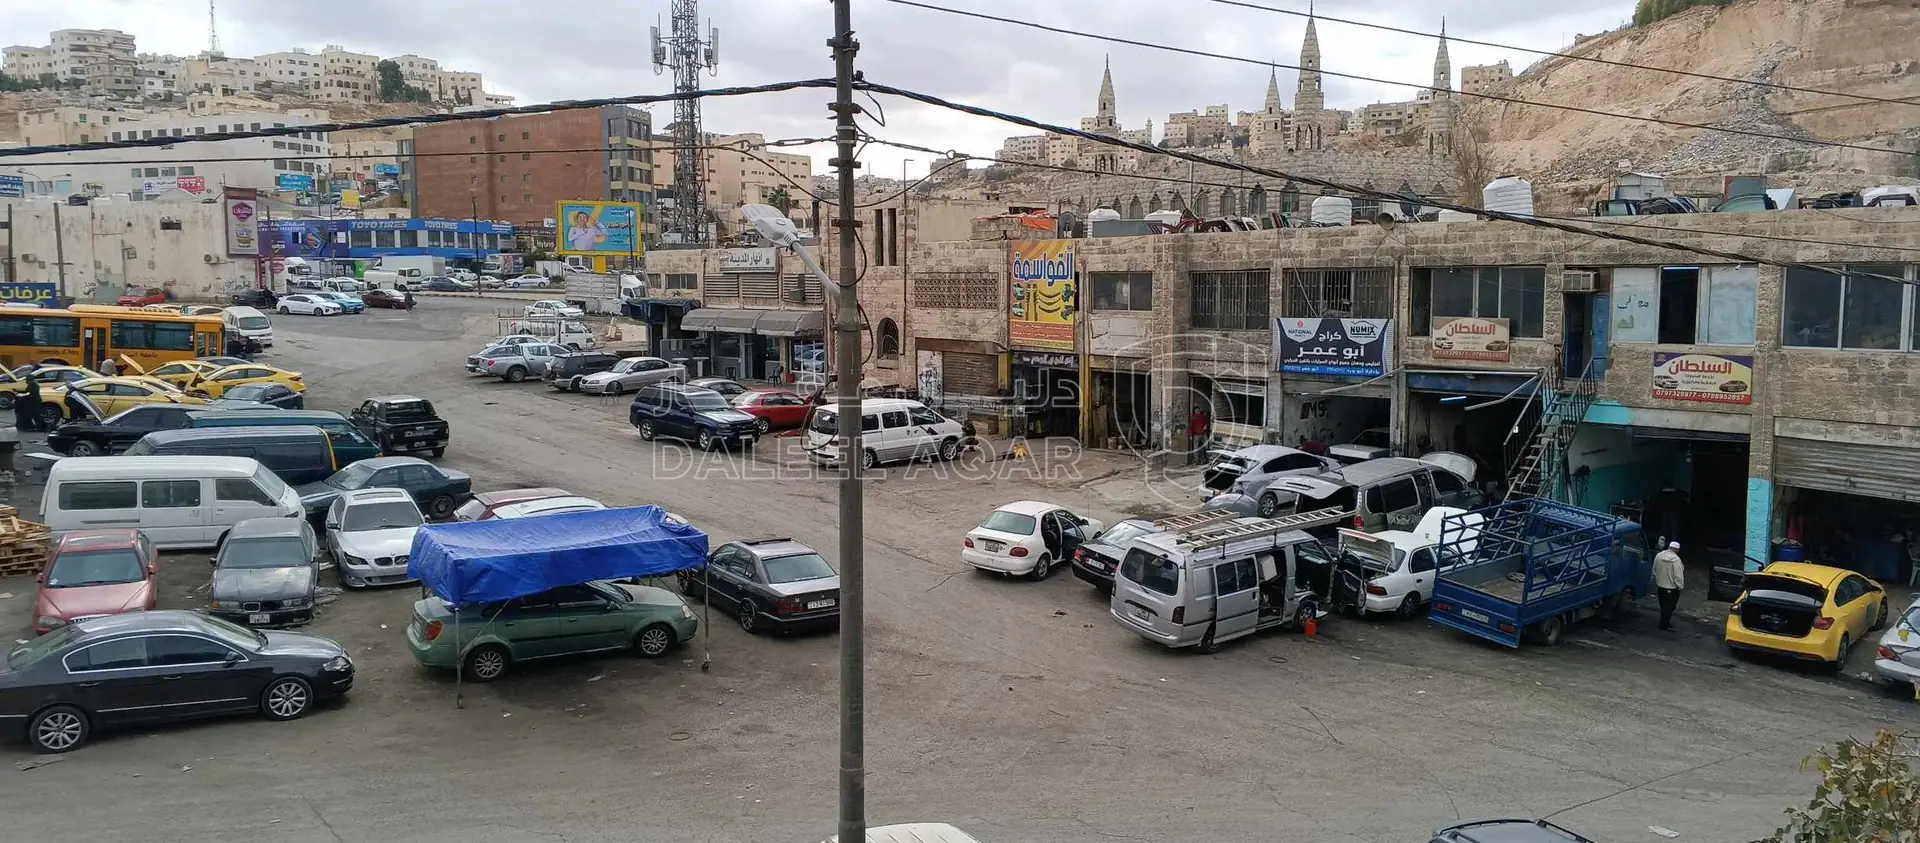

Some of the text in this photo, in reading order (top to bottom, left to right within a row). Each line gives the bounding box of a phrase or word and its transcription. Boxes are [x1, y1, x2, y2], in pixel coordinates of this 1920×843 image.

[351, 221, 407, 229] TOYO TIRES
[0, 286, 52, 301] عرفات
[1350, 326, 1376, 336] NUMIX
[1446, 322, 1496, 337] السلطان
[1319, 331, 1342, 341] كراج
[1297, 346, 1338, 357] عمر
[1669, 359, 1732, 375] السلطان
